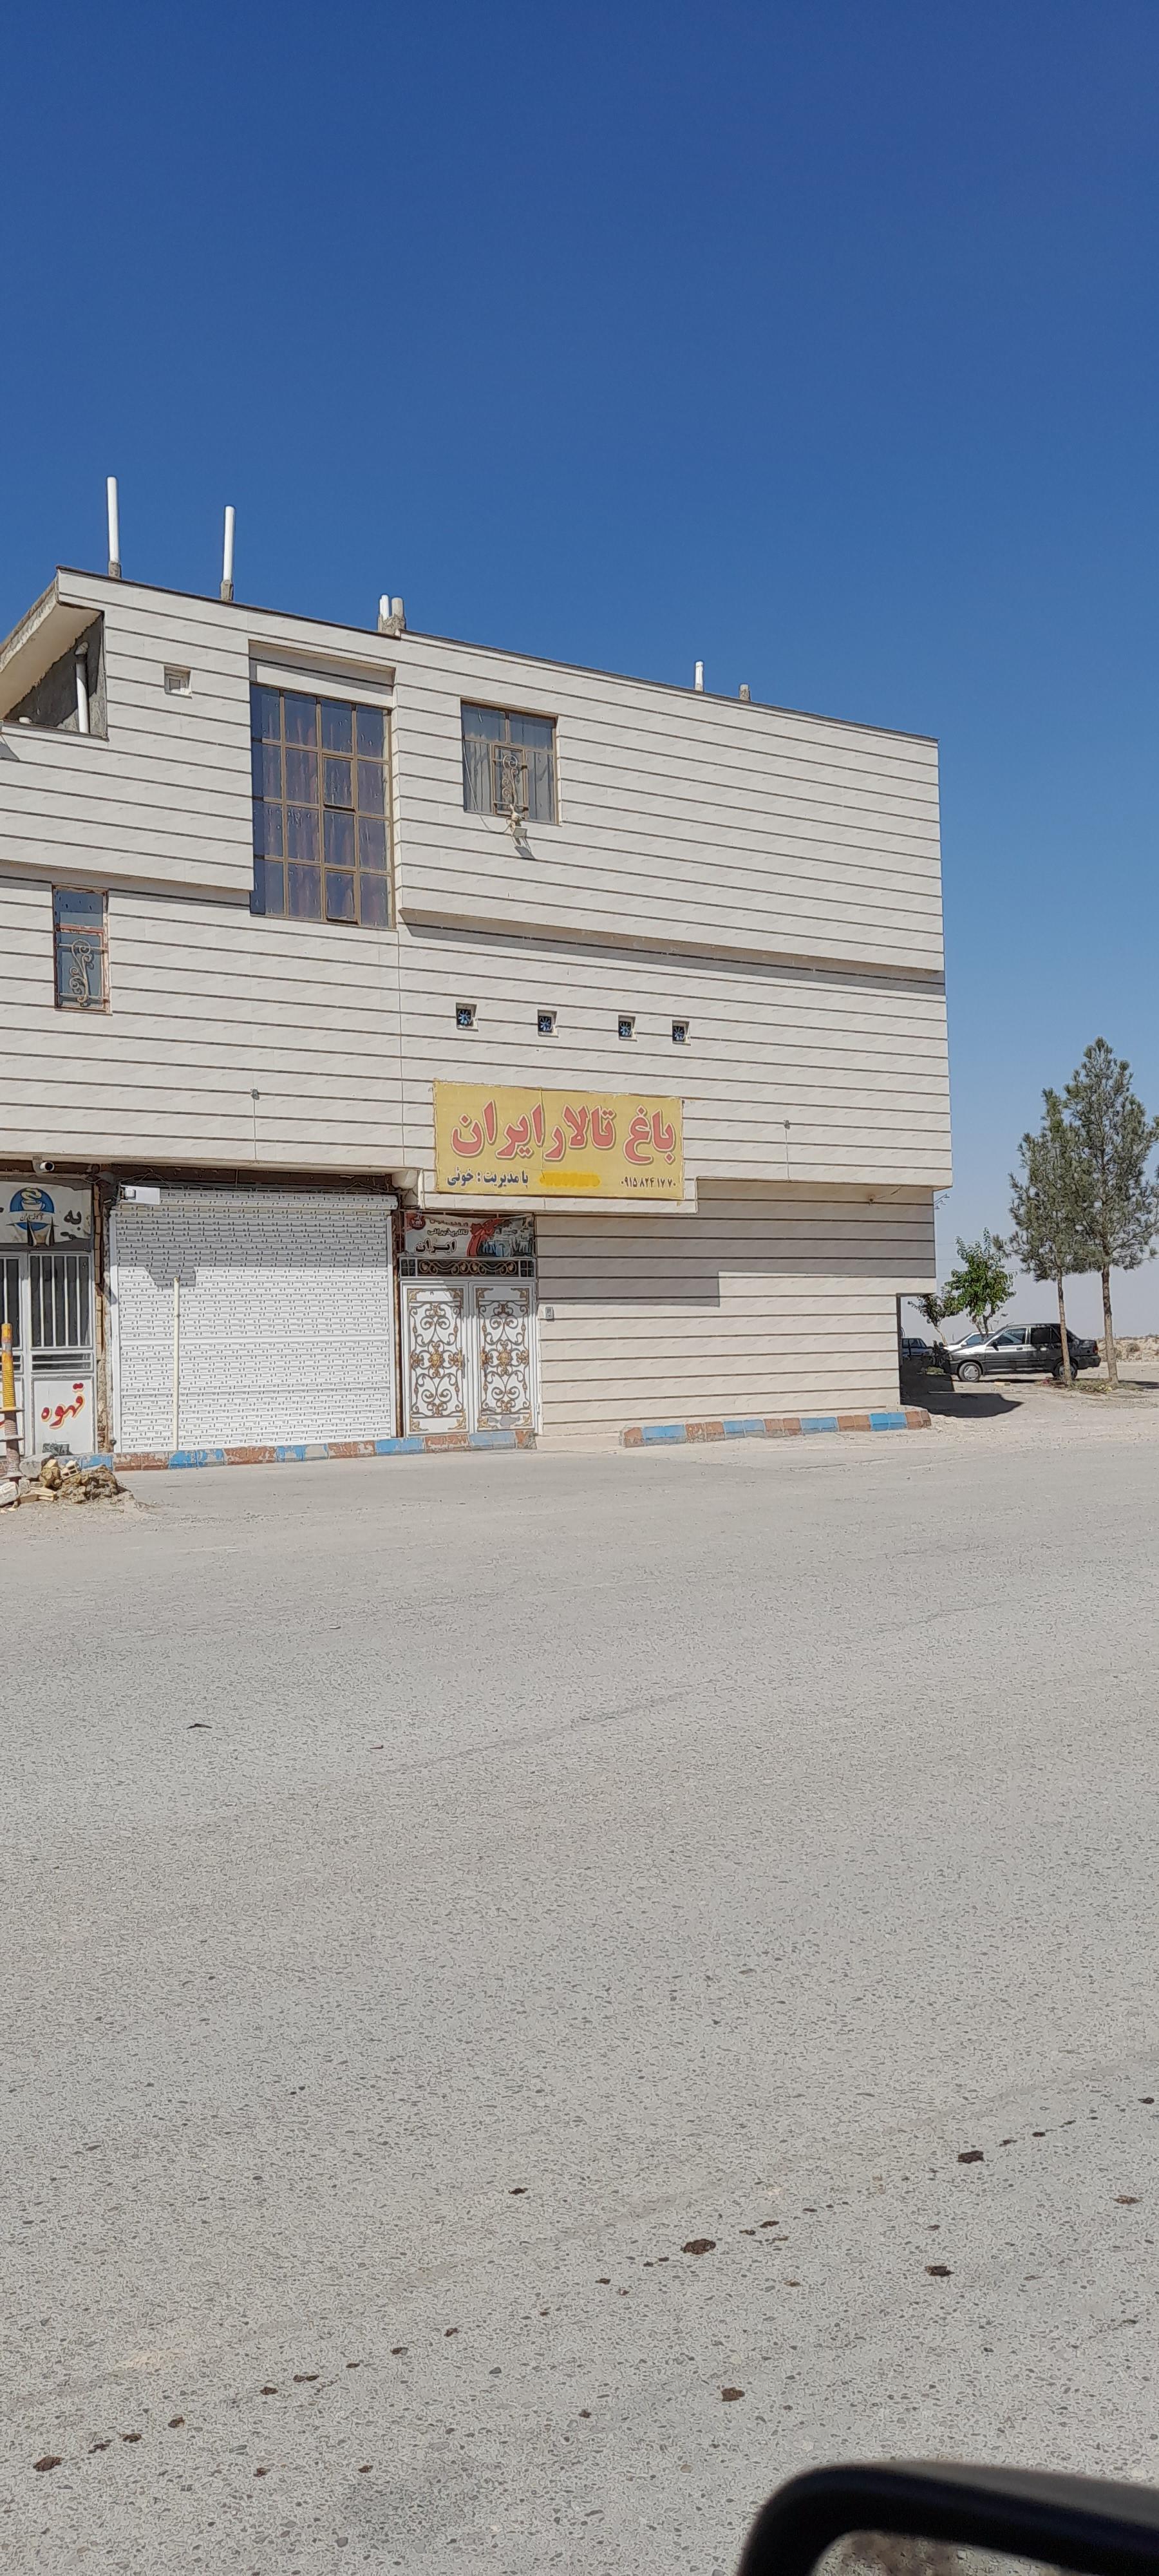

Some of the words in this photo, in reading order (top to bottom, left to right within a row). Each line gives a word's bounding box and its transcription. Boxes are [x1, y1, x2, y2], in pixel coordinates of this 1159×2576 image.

[451, 1099, 543, 1160] ایران
[543, 1104, 616, 1162] تالار
[623, 1104, 677, 1164] باغ
[484, 1171, 520, 1188] مدیریت
[522, 1170, 529, 1188] با
[415, 1238, 457, 1255] ایران
[41, 1382, 84, 1430] قهوه
